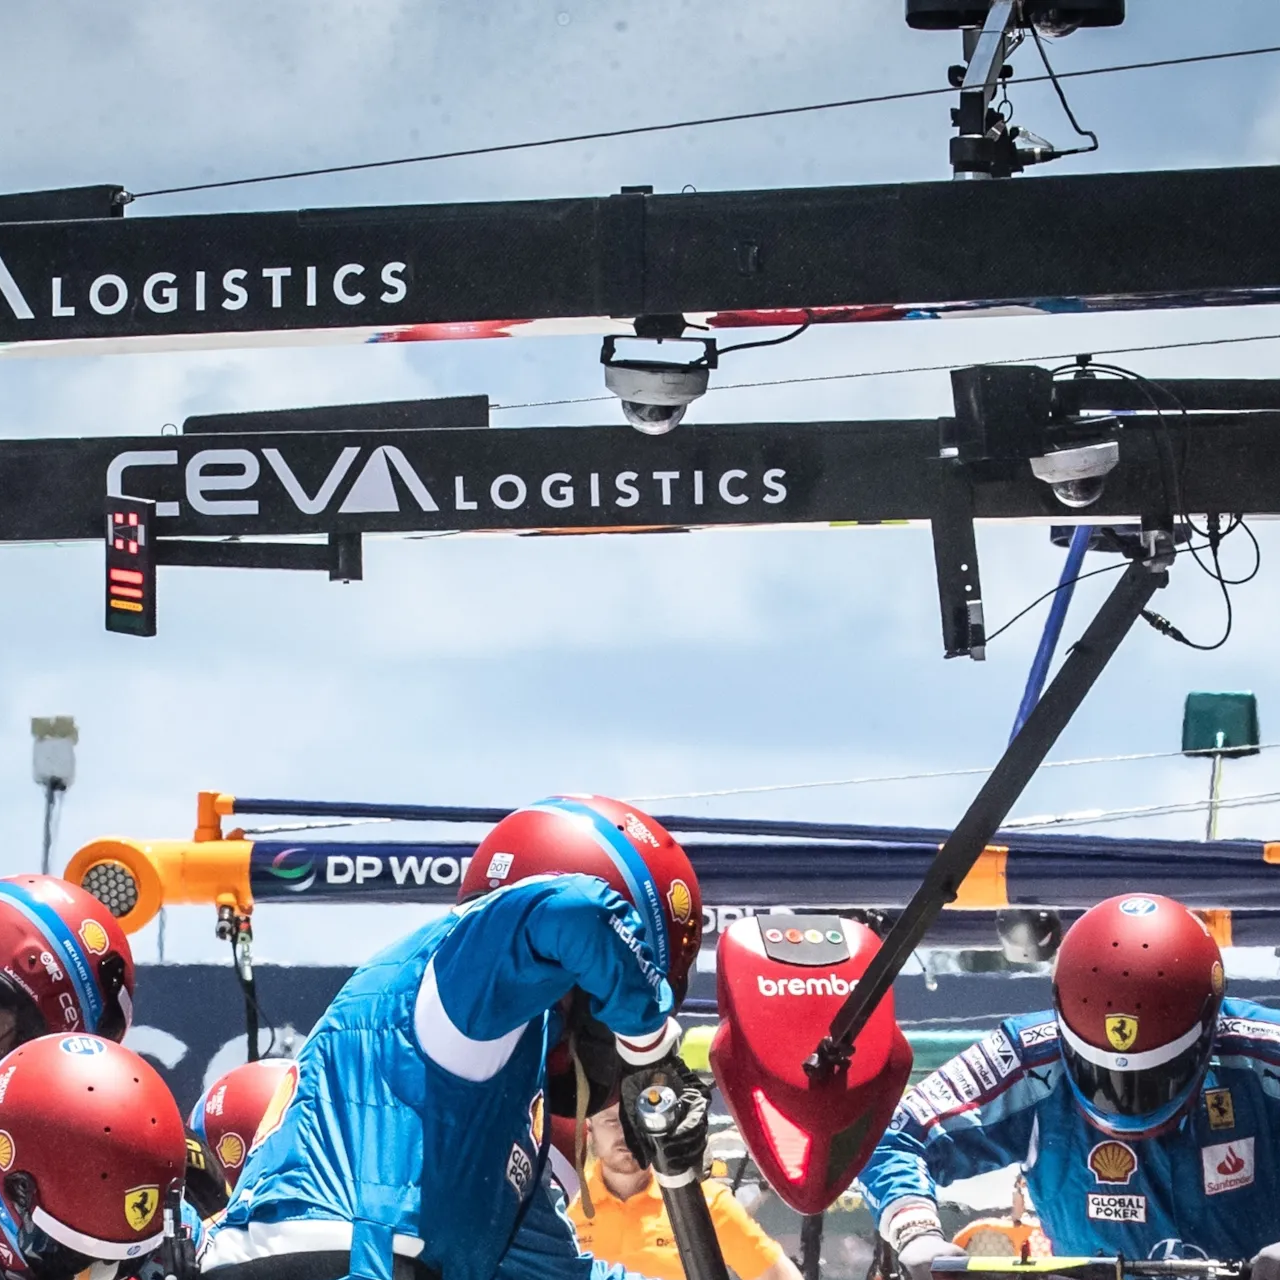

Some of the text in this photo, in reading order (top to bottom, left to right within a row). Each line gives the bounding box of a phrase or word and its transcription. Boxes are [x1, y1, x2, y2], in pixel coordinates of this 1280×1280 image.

[52, 261, 408, 318] LOGISTICS
[455, 468, 788, 511] LOGISTICS
[326, 855, 383, 885] DP
[63, 939, 88, 982] RICHARD
[1207, 1175, 1252, 1192] Santander
[1091, 1197, 1144, 1209] GLOBAL
[1095, 1207, 1139, 1219] POKER
